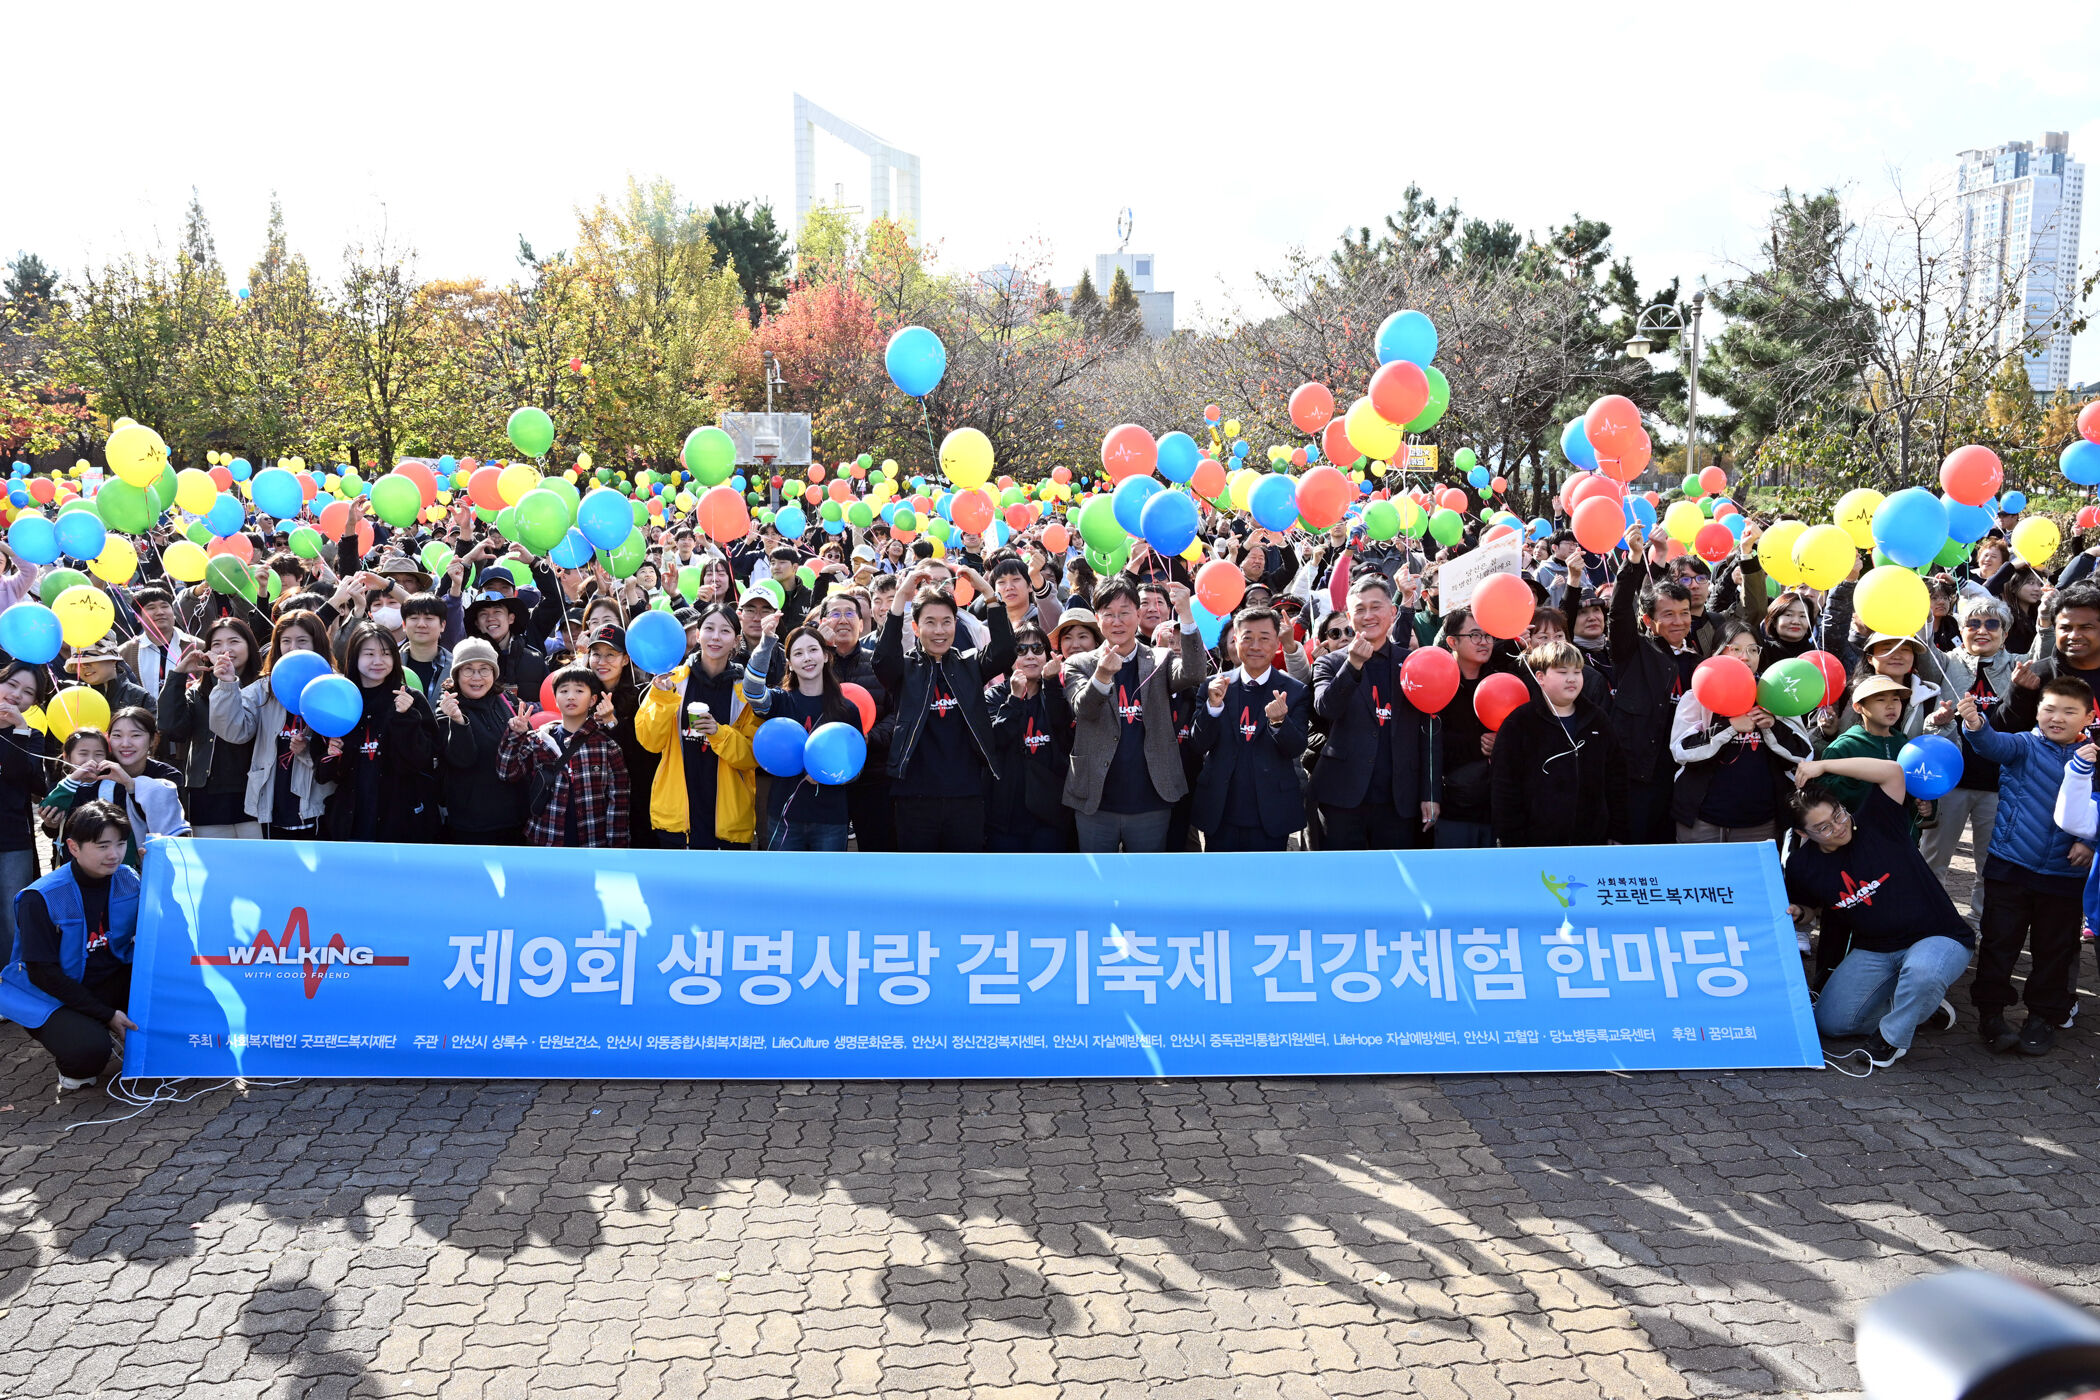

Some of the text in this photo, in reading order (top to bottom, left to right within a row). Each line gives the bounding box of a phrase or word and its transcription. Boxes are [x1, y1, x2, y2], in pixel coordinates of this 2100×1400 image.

[1597, 877, 1659, 886] 사회복지법인
[1597, 887, 1734, 905] 굿프랜드복지재단
[1834, 880, 1880, 908] WALKING
[228, 946, 374, 964] WALKING
[443, 925, 1750, 1005] 제9회 생명사랑 걷기축제 건강체험 한마당
[188, 1034, 213, 1048] 주최
[226, 1034, 296, 1048] 사회복지법인
[300, 1034, 397, 1048] 굿프랜드복지재단
[413, 1034, 438, 1048] 주관
[451, 1034, 488, 1049] 안산시
[491, 1035, 528, 1049] 상록수
[606, 1035, 642, 1049] 안산시
[772, 1036, 829, 1049] LifeCulture
[911, 1035, 947, 1050] 안산시
[1052, 1034, 1088, 1048] 안산시
[1170, 1033, 1206, 1047] 안산시
[1333, 1033, 1383, 1047] LifeHope
[1463, 1030, 1500, 1045] 안산시
[1503, 1029, 1539, 1044] 고혈압
[1549, 1027, 1656, 1043] 당뇨병등록교육센터
[1671, 1026, 1697, 1041] 후원
[1708, 1026, 1757, 1041] 꿈의교회
